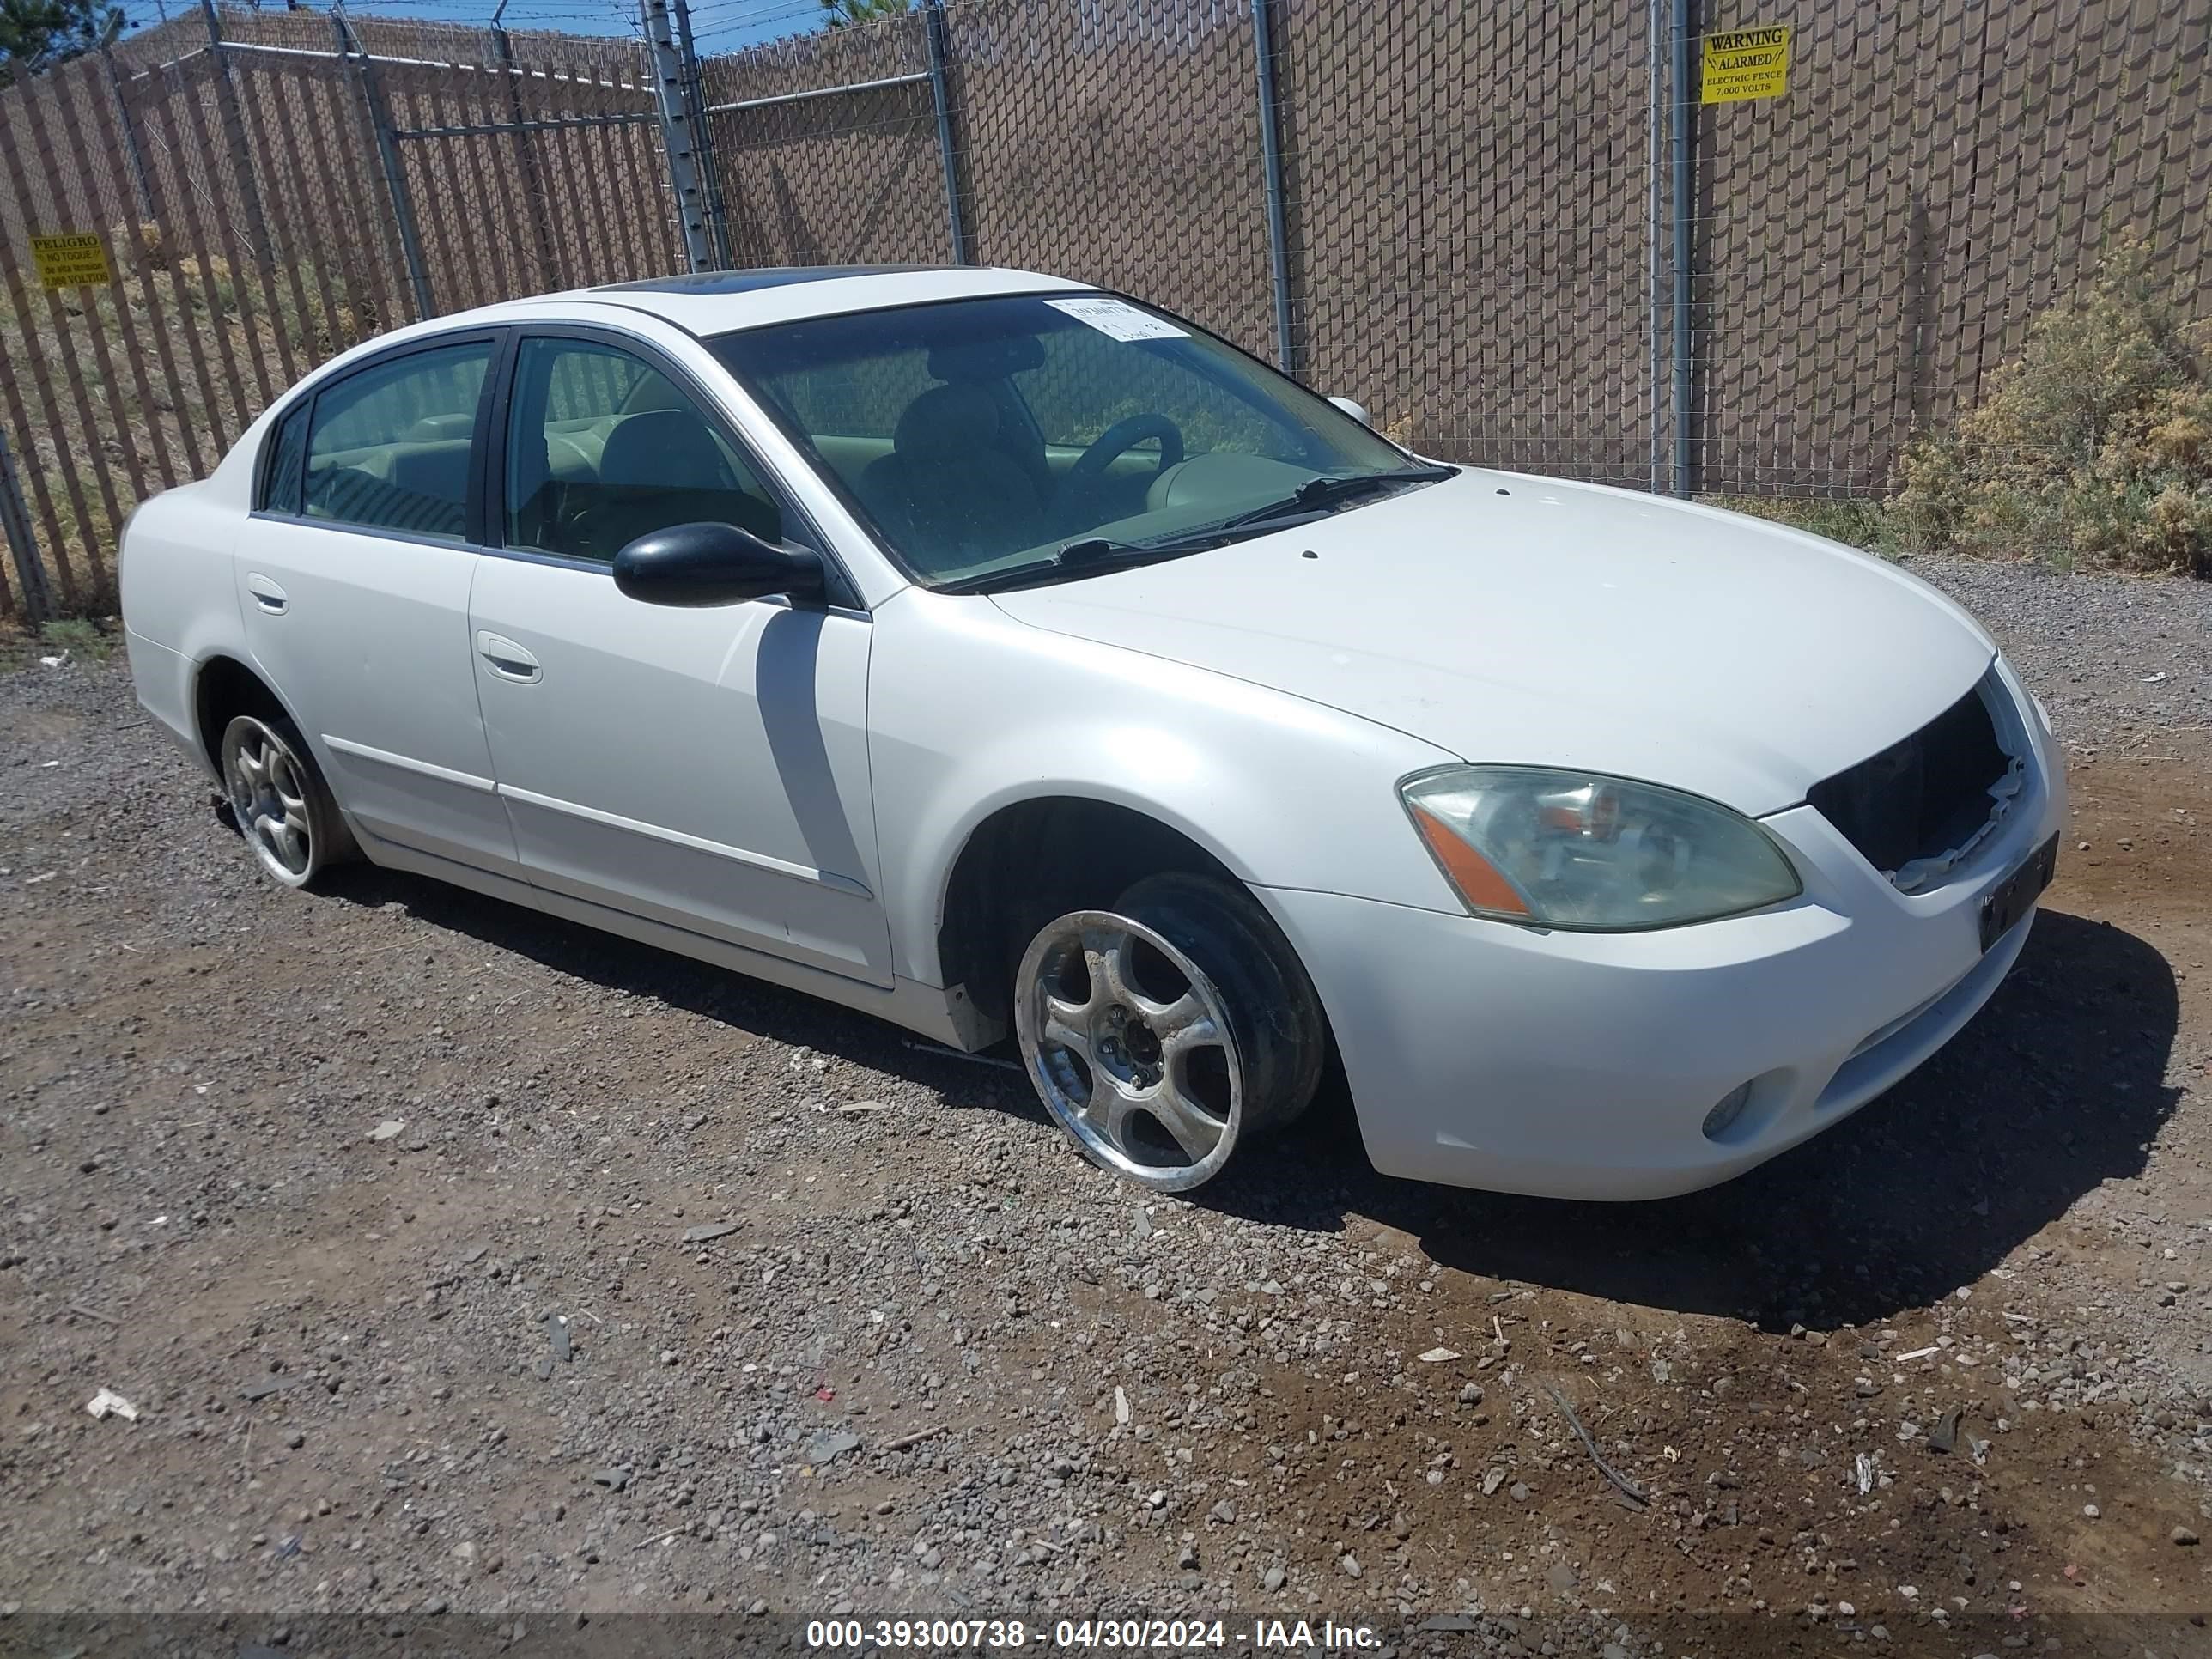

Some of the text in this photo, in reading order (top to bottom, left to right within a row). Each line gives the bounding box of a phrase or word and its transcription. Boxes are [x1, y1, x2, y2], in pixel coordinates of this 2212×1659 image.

[1711, 28, 1782, 51] WARNING
[1718, 53, 1772, 70] ALARMED
[1707, 70, 1782, 86] ELECTRIC FENCE
[1716, 82, 1771, 96] 7,000 VOLTS
[33, 236, 98, 249] PELIGRO
[46, 250, 91, 262] NO TOQUE
[67, 272, 109, 284] VOLTIOS
